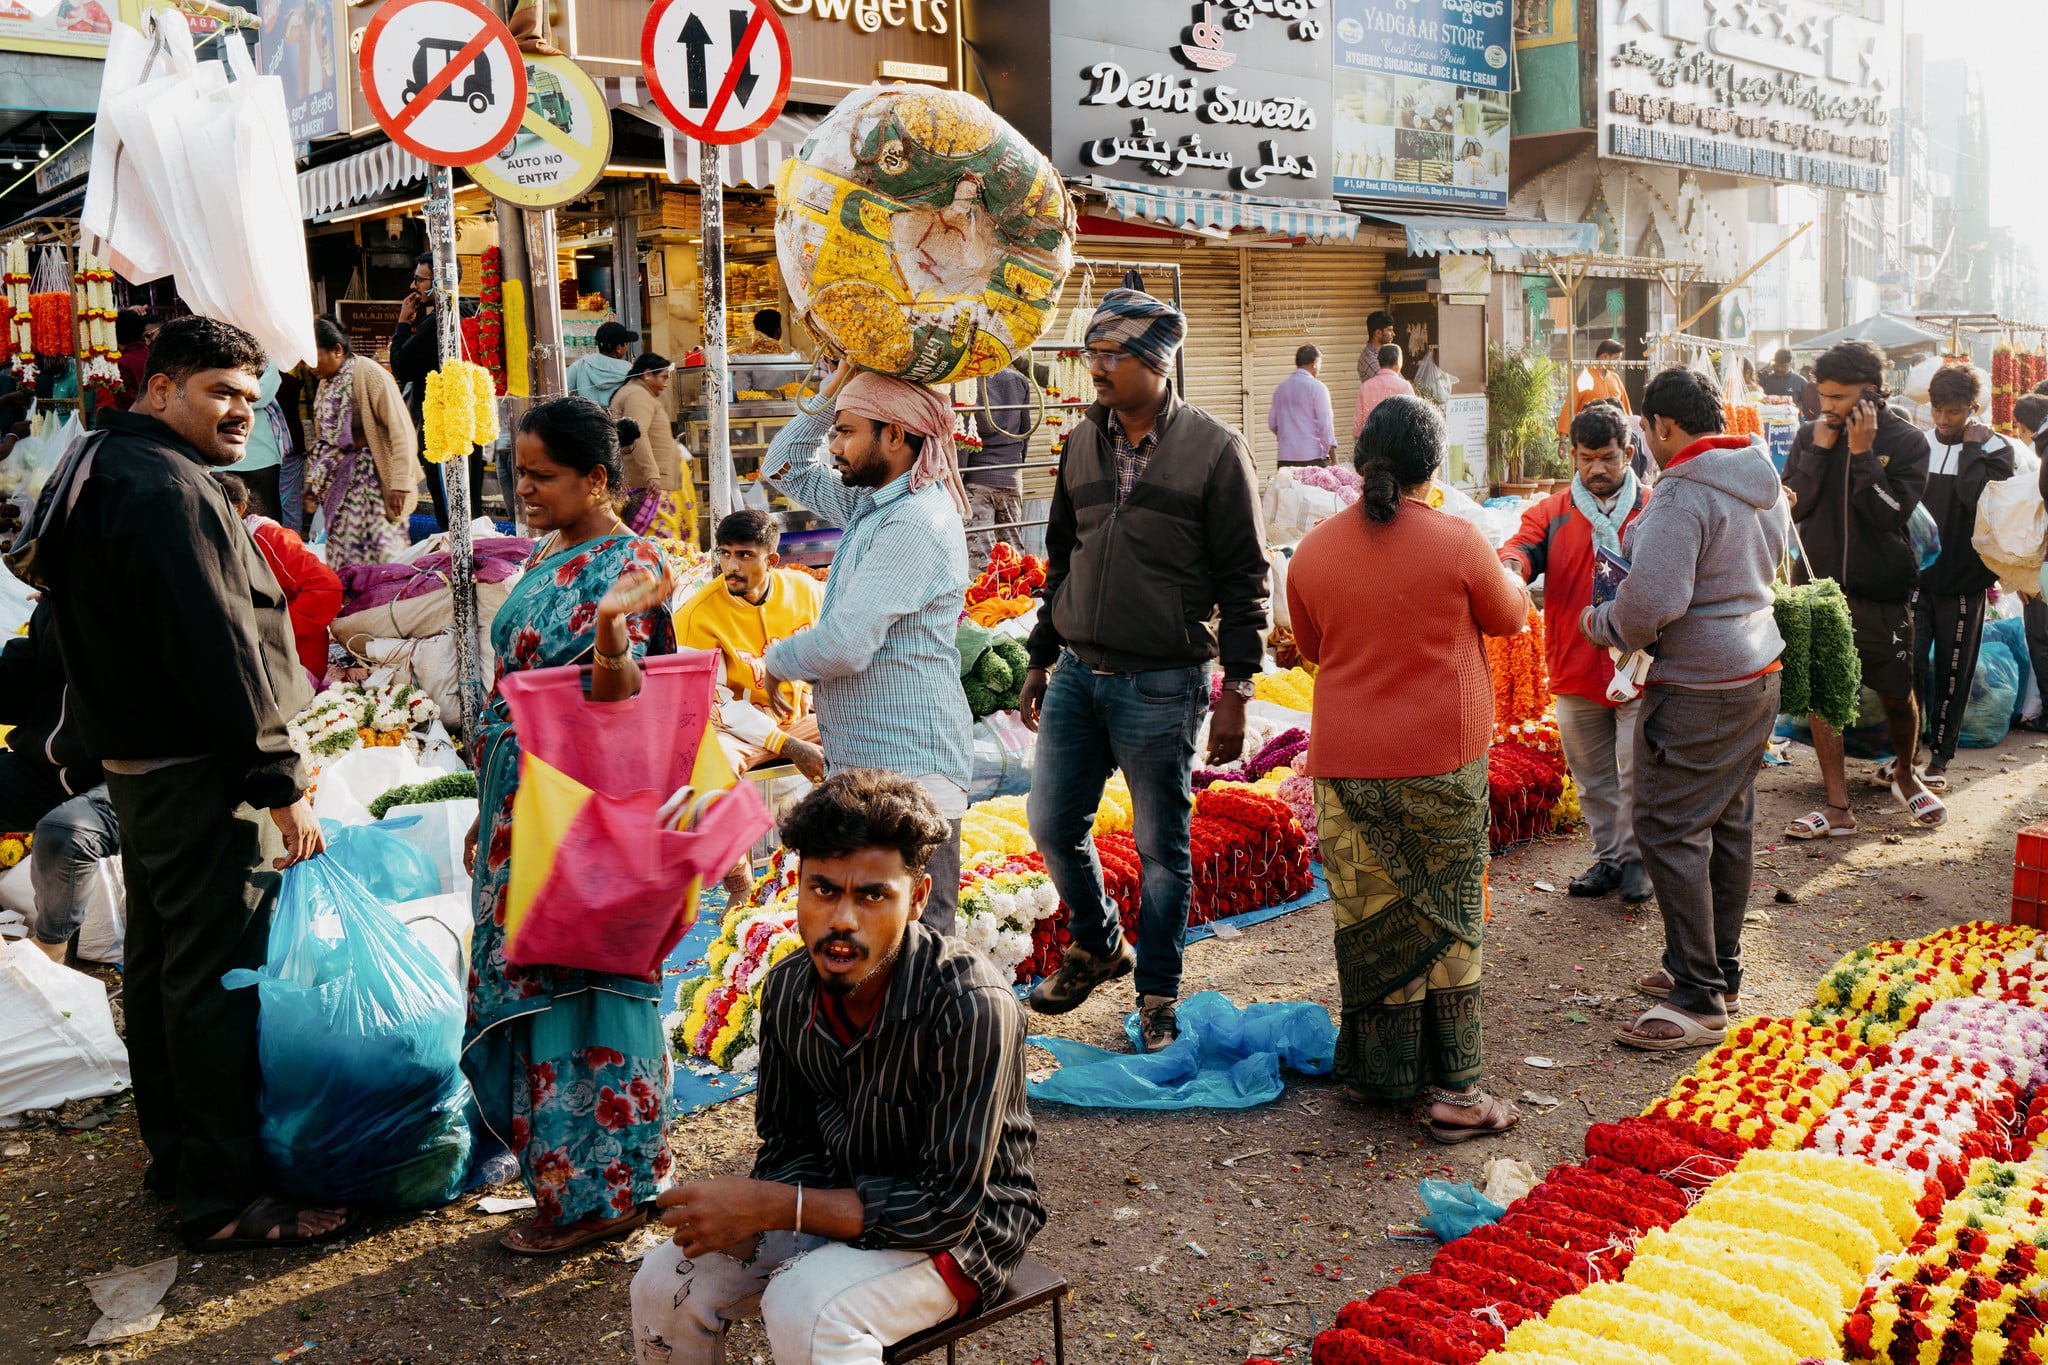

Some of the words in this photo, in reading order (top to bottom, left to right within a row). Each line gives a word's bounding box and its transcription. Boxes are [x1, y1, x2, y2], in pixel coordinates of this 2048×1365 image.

[1365, 6, 1438, 42] YADGAAR
[1441, 23, 1485, 50] STORE
[1381, 38, 1406, 53] Cool
[1408, 43, 1437, 60] Lassi
[1440, 48, 1467, 66] Point
[889, 64, 918, 76] SINCE
[921, 67, 942, 79] 1975
[1345, 51, 1383, 69] HYGIENIC
[1383, 56, 1429, 76] SUGARCANE
[1429, 65, 1451, 80] JUICE
[1452, 69, 1458, 80] &
[1459, 70, 1472, 83] ICE
[1472, 72, 1498, 87] CREAM
[1091, 62, 1199, 113] Delhi
[1208, 85, 1317, 131] Sweets
[301, 118, 325, 138] BAKERY
[507, 157, 541, 170] AUTO
[544, 154, 563, 165] NO
[518, 171, 558, 185] ENTRY
[1380, 182, 1387, 191] KR
[1388, 182, 1397, 192] City
[1398, 183, 1415, 193] Market
[1431, 187, 1441, 197] Shop
[352, 312, 383, 320] BALAJI
